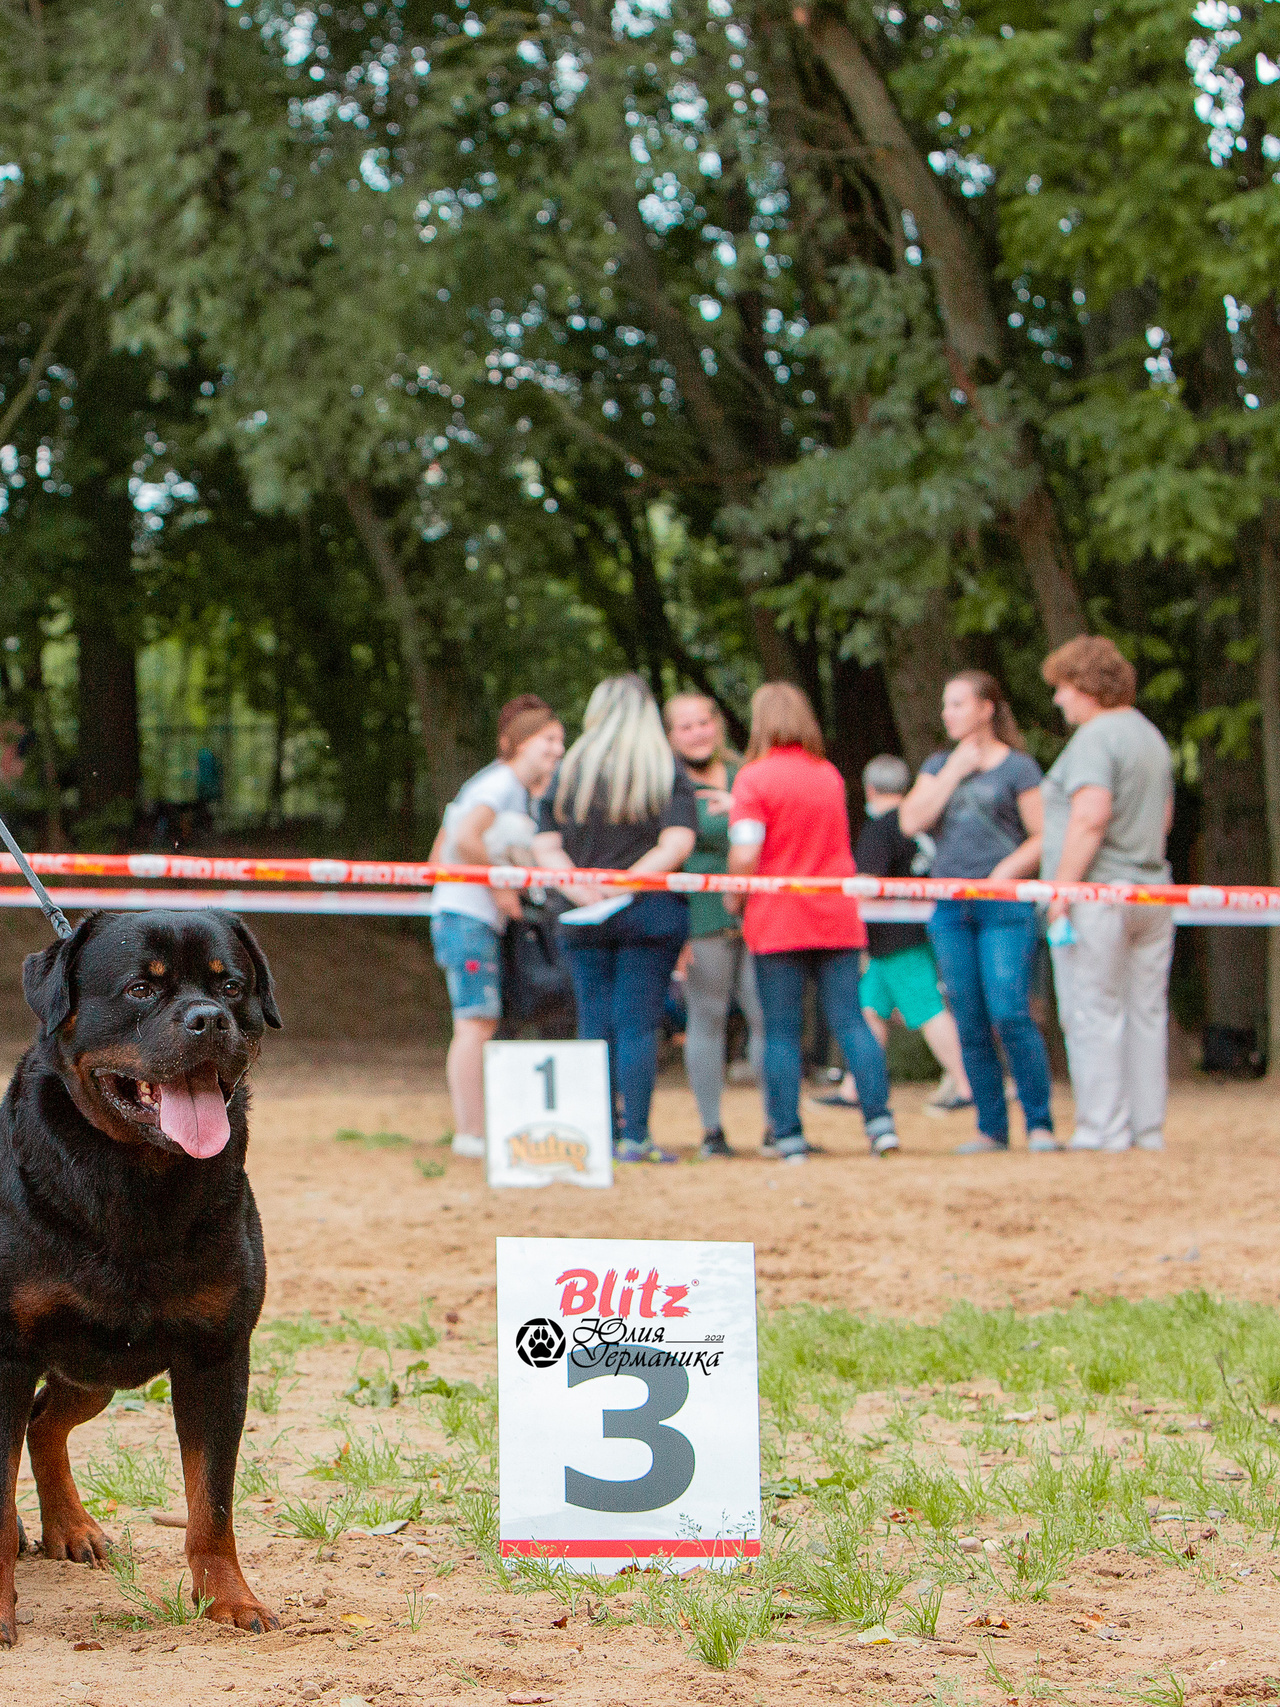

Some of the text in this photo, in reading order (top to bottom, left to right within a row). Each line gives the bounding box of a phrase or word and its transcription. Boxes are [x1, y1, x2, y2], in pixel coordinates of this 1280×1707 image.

[535, 1056, 556, 1110] 1
[555, 1267, 693, 1319] Blitz
[564, 1344, 696, 1513] 3
